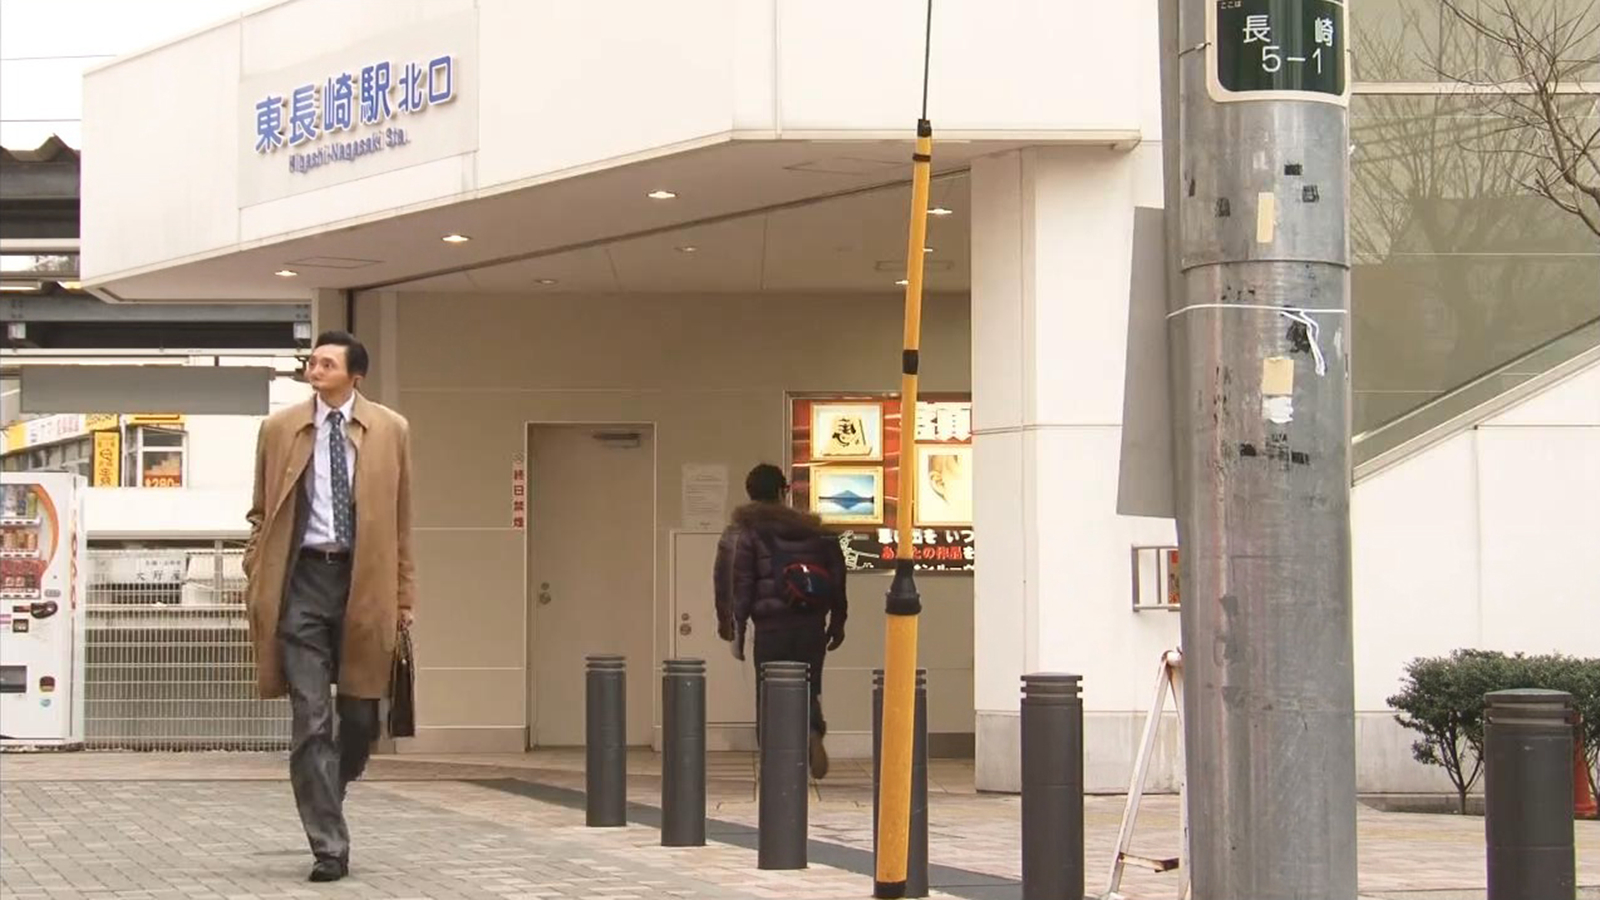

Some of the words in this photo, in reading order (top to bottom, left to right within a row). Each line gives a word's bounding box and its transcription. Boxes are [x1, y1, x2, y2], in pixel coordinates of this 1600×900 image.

[255, 55, 452, 152] 東長崎駅北口
[289, 130, 385, 174] Higashi-Nagasaki
[386, 127, 410, 148] Sta.
